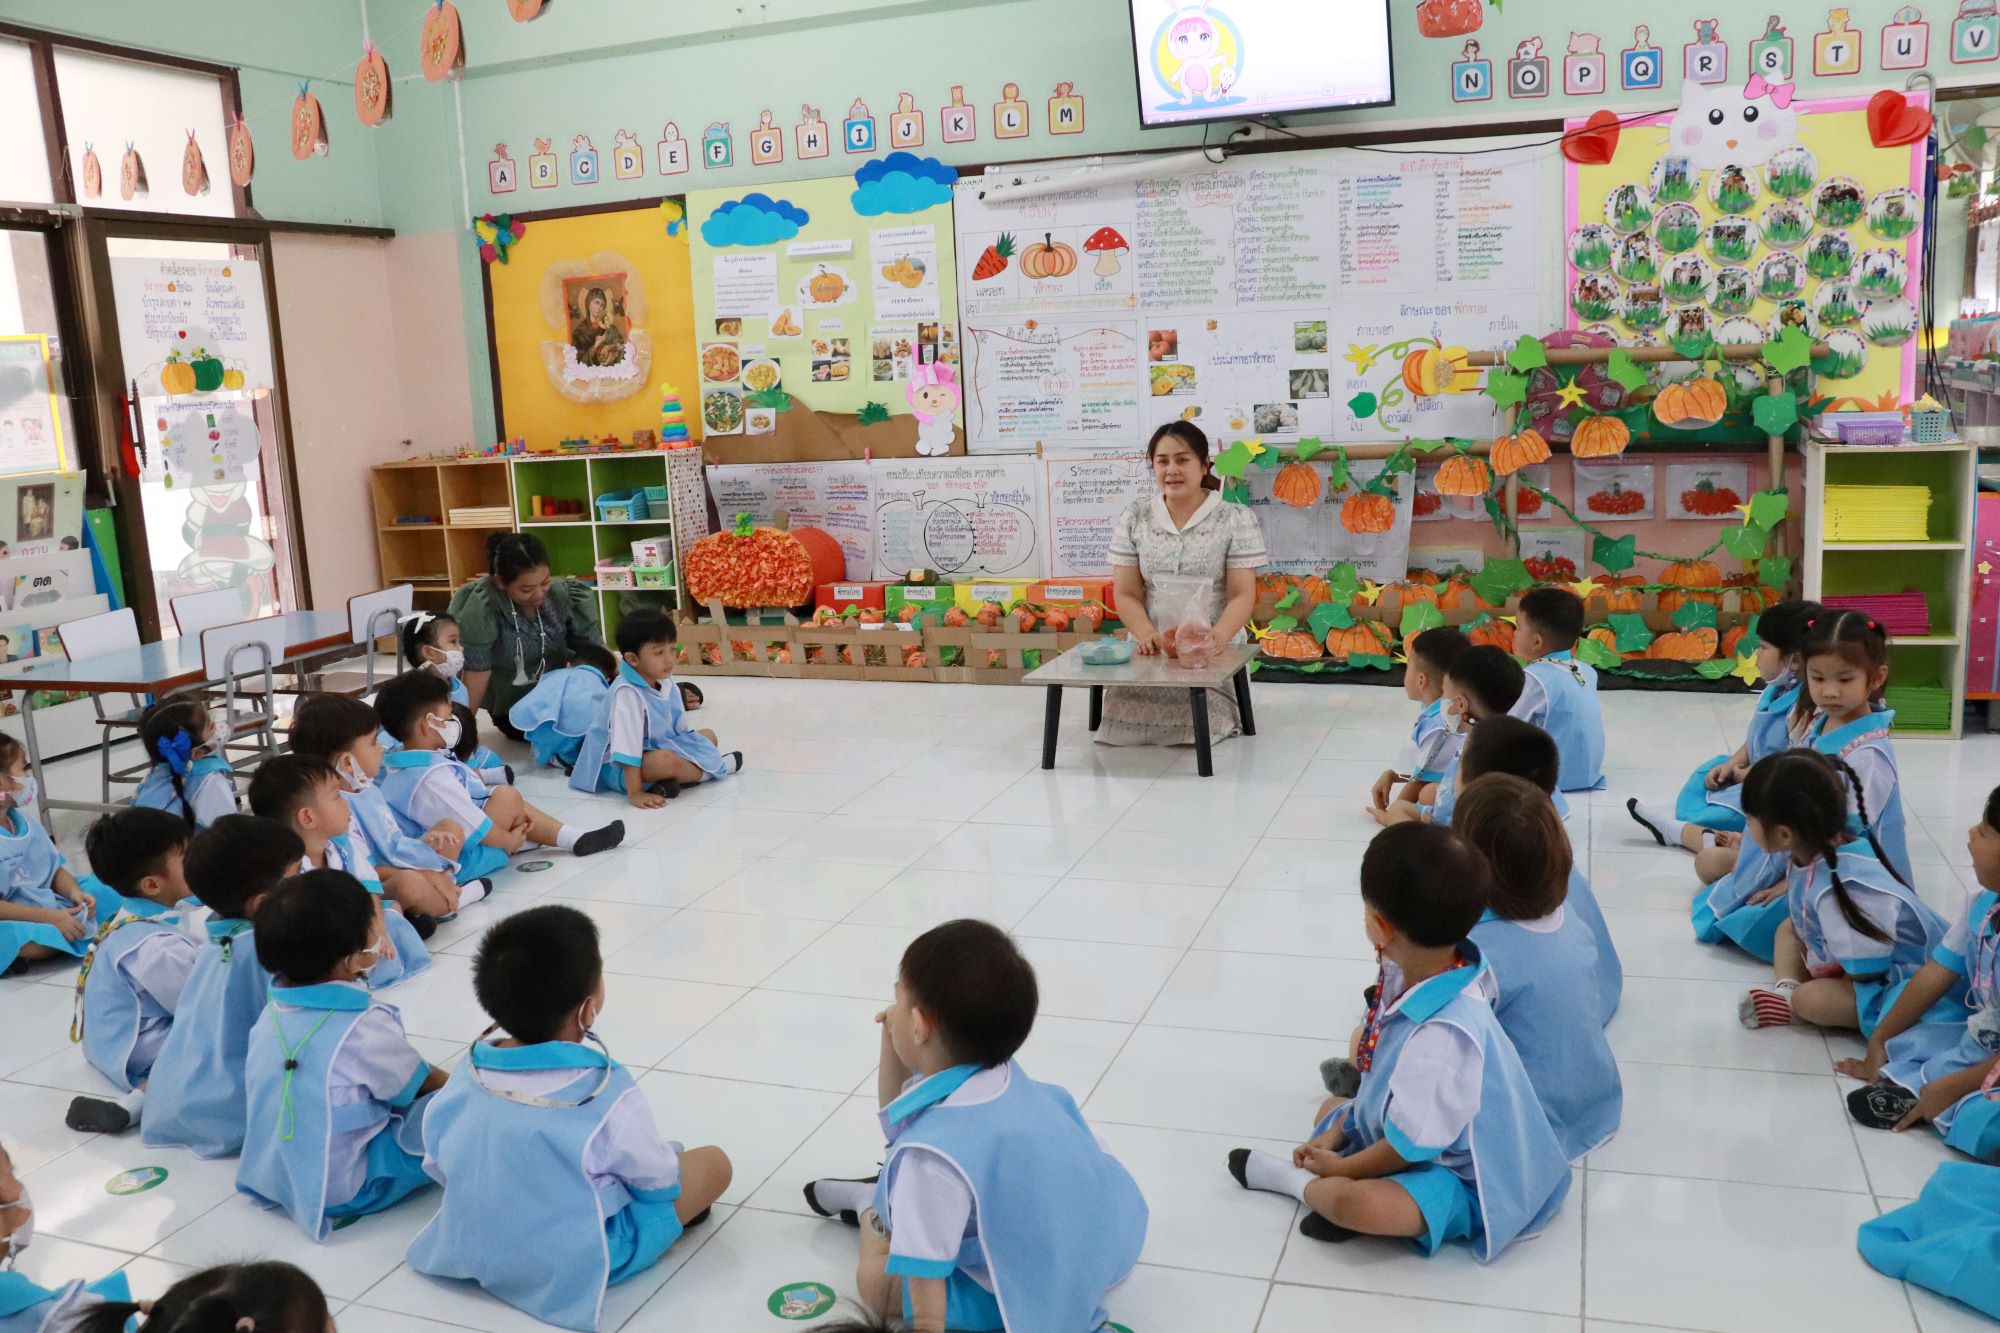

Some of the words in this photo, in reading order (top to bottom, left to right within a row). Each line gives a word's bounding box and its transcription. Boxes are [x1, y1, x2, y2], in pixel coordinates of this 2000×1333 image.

[1969, 29, 1984, 48] V
[1831, 45, 1844, 62] T
[1897, 38, 1912, 56] U
[1699, 55, 1713, 72] R
[1765, 51, 1777, 68] S
[1578, 66, 1591, 83] P
[1634, 60, 1650, 77] Q
[1465, 72, 1479, 89] N
[1521, 69, 1536, 86] O
[1007, 113, 1017, 128] L
[1060, 107, 1073, 123] M
[902, 122, 912, 137] J
[953, 117, 964, 132] K
[807, 133, 818, 149] H
[855, 128, 864, 143] I
[713, 145, 722, 159] F
[761, 140, 773, 154] G
[623, 156, 633, 170] D
[669, 150, 678, 164] E
[539, 164, 548, 178] B
[579, 161, 590, 175] C
[498, 169, 508, 184] A
[1454, 301, 1488, 314] ฟักทอง
[1357, 323, 1394, 337] ภายนอก
[1346, 377, 1367, 389] ดอก
[1416, 397, 1444, 412] เปลือก
[1346, 413, 1363, 431] ใบ
